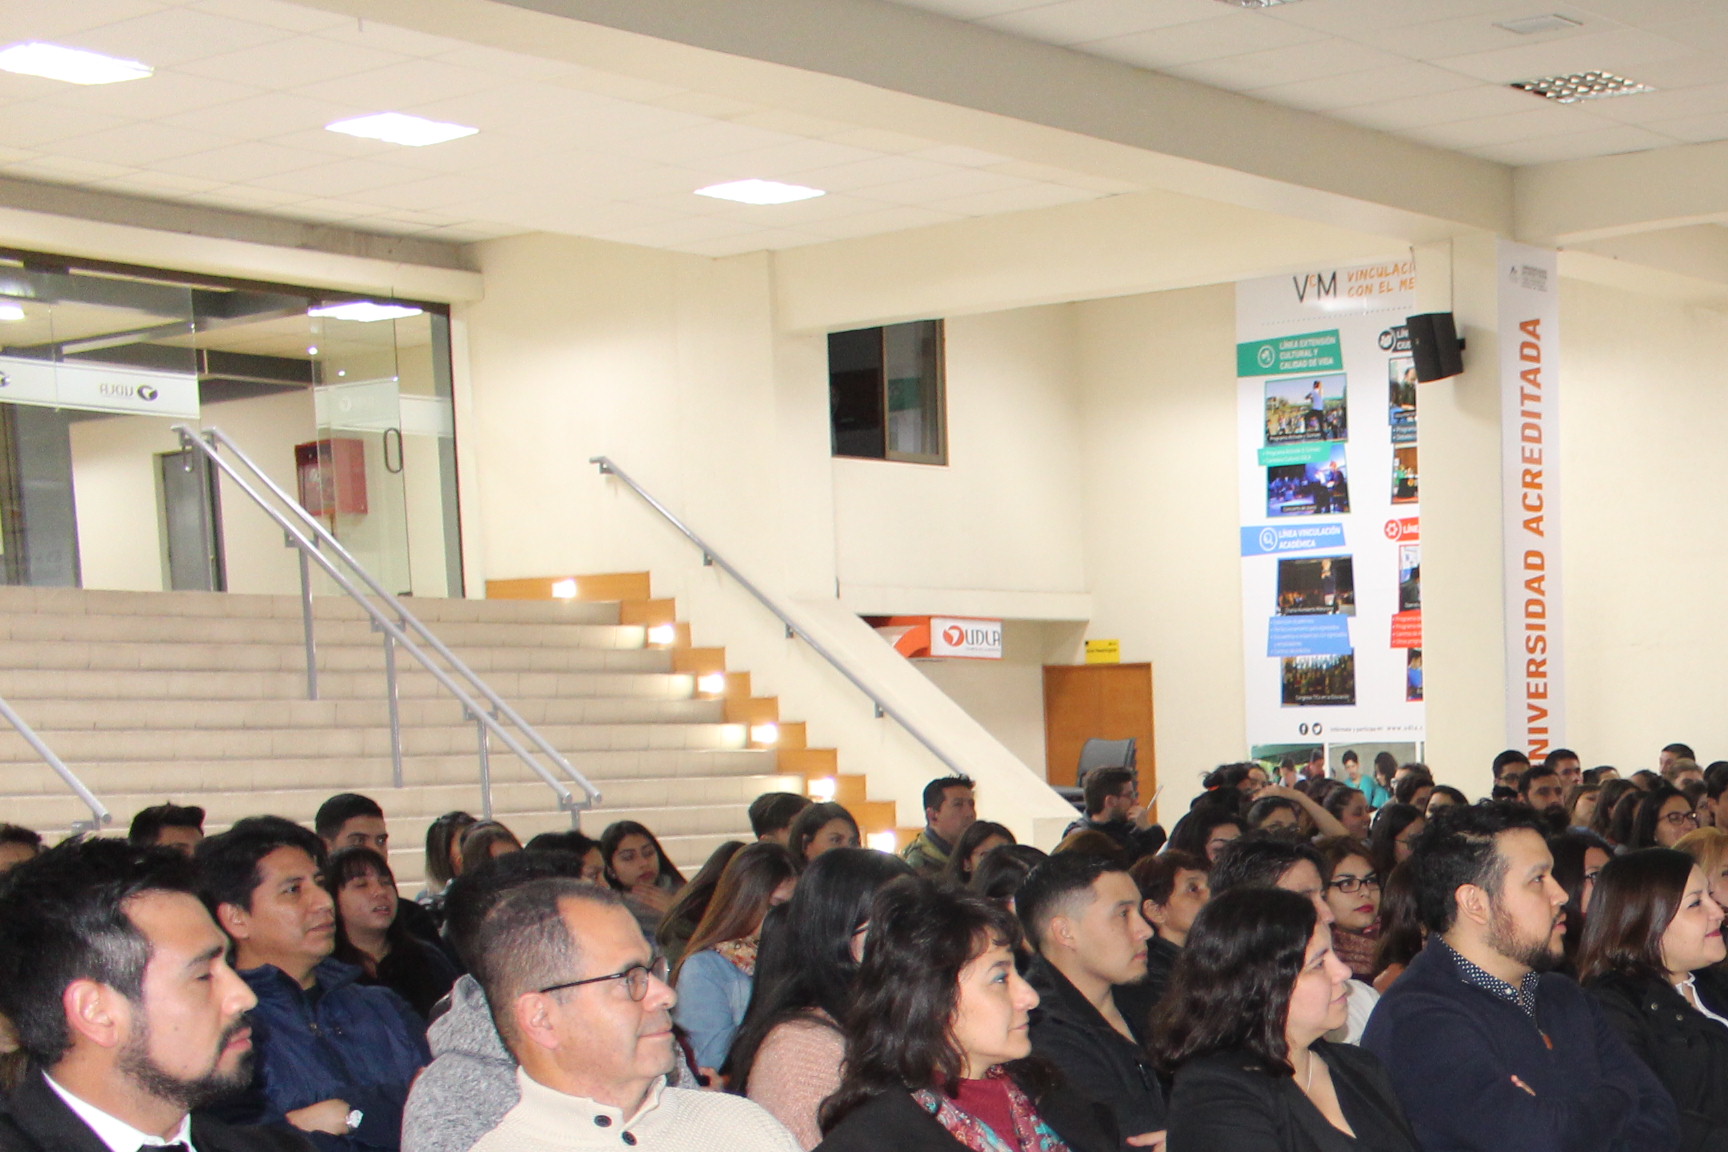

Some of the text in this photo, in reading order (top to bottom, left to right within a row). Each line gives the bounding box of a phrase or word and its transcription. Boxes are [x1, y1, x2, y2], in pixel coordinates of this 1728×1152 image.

[1347, 283, 1374, 298] CON
[1379, 280, 1394, 295] EL
[1519, 318, 1544, 537] ACREDITADA
[964, 628, 1001, 647] UDLA
[1523, 549, 1549, 763] NIVERSIDAD
